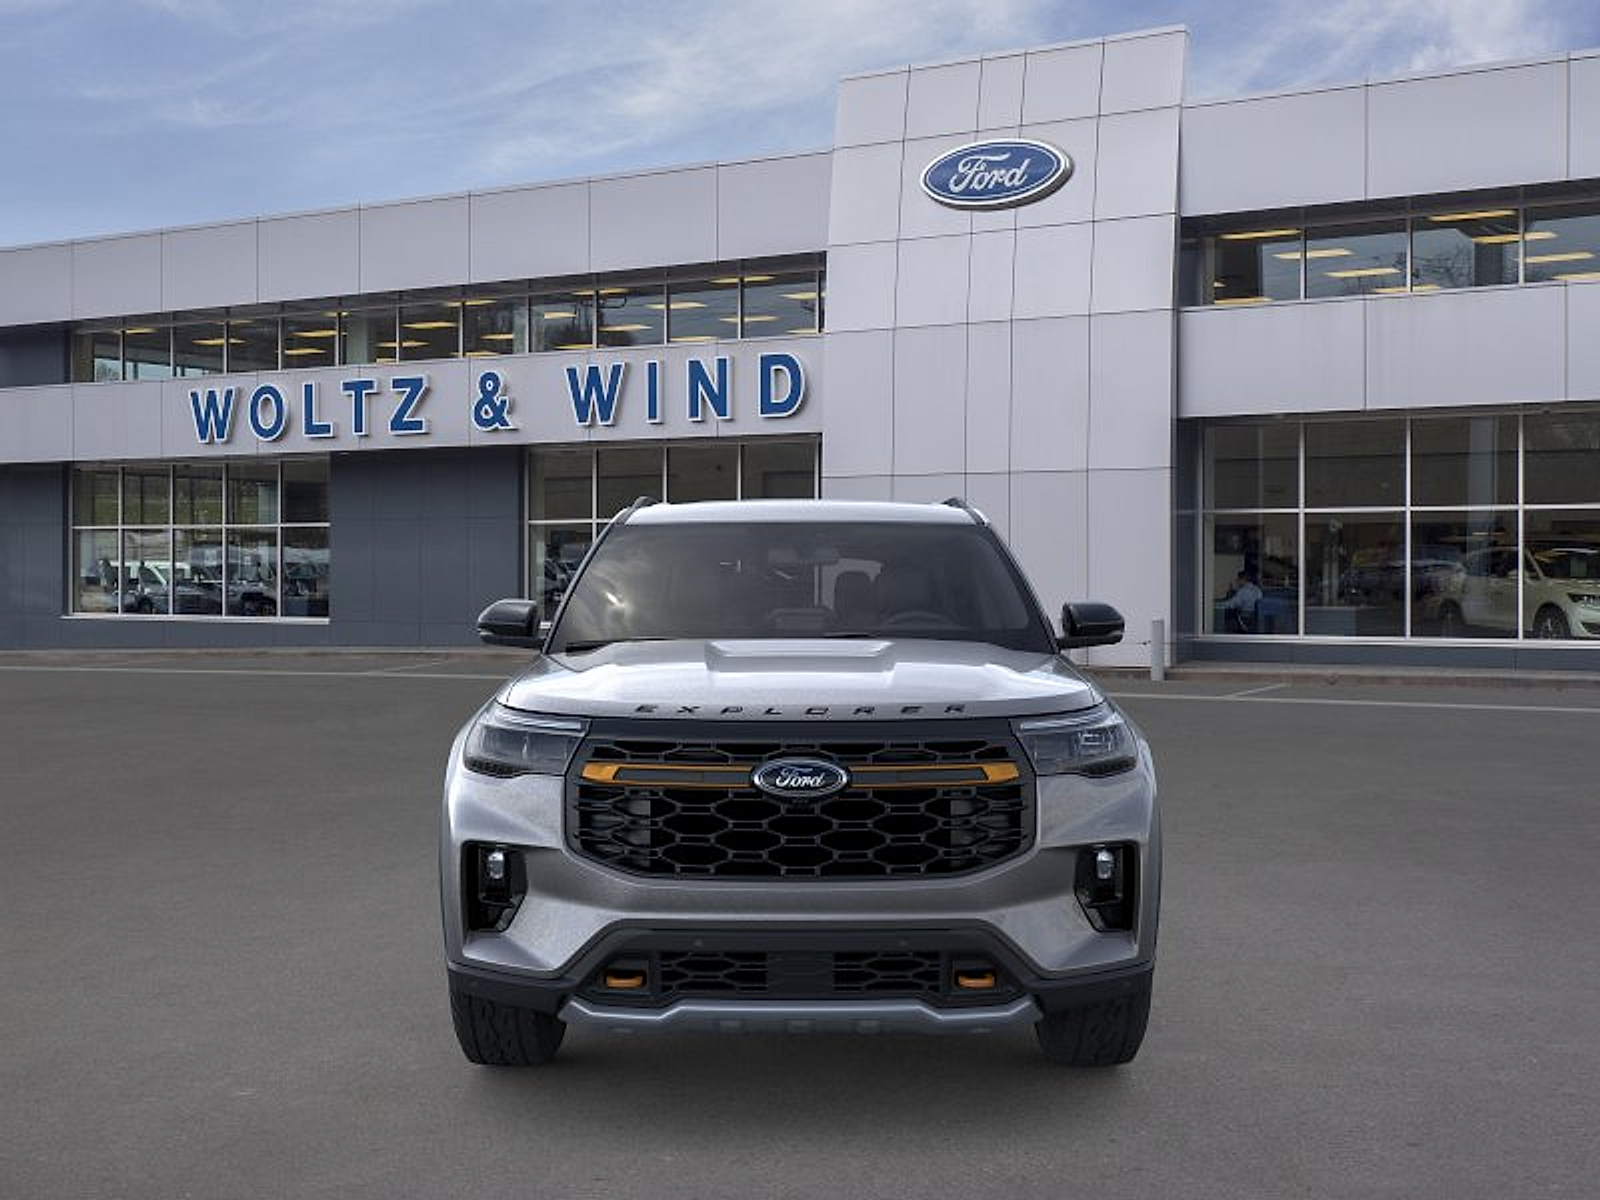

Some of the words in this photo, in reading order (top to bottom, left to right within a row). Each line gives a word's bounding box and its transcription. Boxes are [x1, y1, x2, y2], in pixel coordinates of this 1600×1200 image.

[949, 152, 1031, 194] Ford
[190, 375, 430, 444] WOLTZ
[472, 370, 518, 432] &
[565, 352, 806, 426] WIND
[634, 703, 966, 716] EXPLORER
[775, 767, 826, 788] Ford
